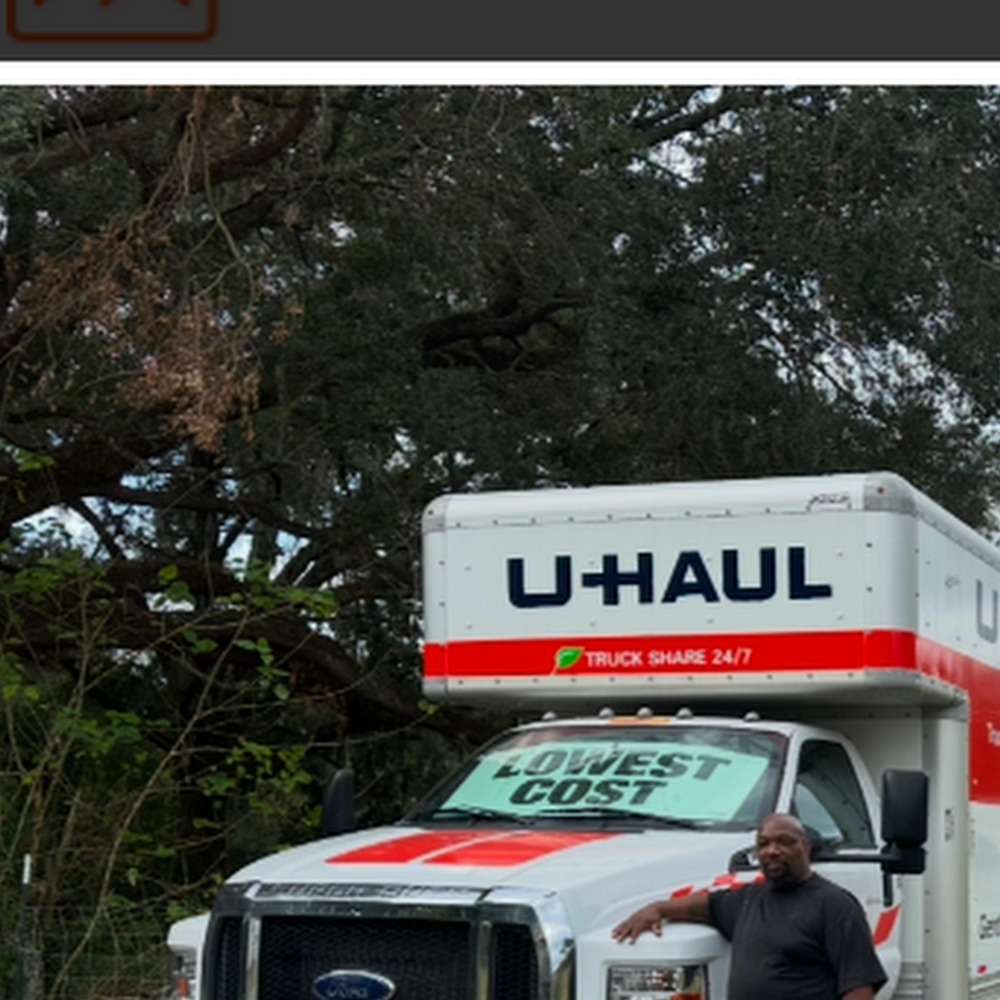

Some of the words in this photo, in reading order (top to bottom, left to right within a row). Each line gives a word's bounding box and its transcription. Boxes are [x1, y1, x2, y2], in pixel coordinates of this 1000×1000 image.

[506, 546, 832, 609] U-HAUL
[586, 651, 643, 667] TRUCK
[648, 649, 707, 665] SHARE
[711, 647, 752, 665] 24/7
[493, 749, 732, 781] LOWEST
[509, 778, 668, 806] COST
